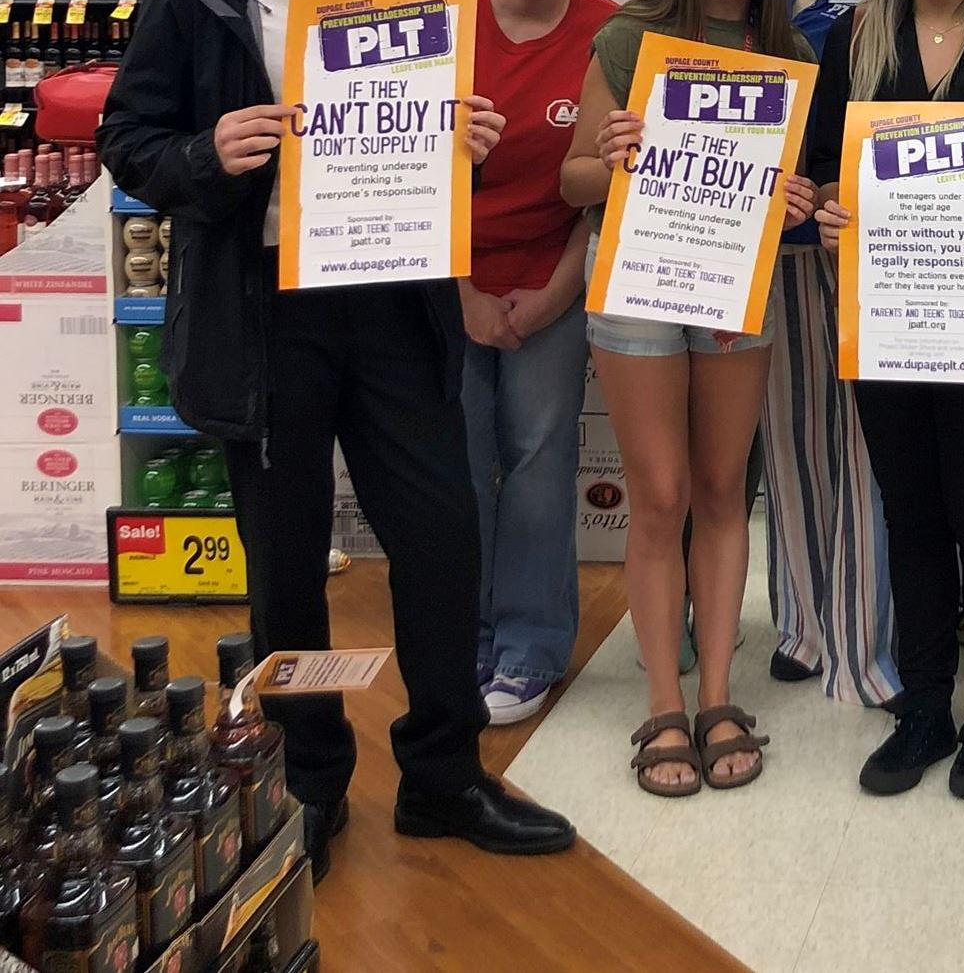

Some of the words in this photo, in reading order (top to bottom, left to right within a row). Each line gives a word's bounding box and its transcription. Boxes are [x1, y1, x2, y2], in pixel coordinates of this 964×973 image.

[347, 18, 424, 66] PLT
[669, 71, 716, 83] PREVENTION
[717, 73, 763, 83] LEADERSHIP
[765, 75, 784, 84] TEAM
[348, 81, 363, 99] IF
[370, 80, 408, 98] THEY
[687, 84, 764, 120] PLT
[290, 102, 369, 136] CAN'T
[376, 100, 429, 134] BUY
[440, 100, 460, 132] IT
[313, 136, 358, 156] DON'T
[360, 136, 418, 154] SUPPLY
[424, 135, 437, 152] IT
[680, 132, 697, 147] IF
[701, 135, 738, 157] THEY
[327, 162, 378, 174] Preventing
[382, 161, 428, 173] underage
[623, 142, 699, 182] CAN'T
[701, 156, 754, 190] BUY
[759, 166, 783, 197] IT
[352, 174, 391, 186] drinking
[394, 175, 402, 184] is
[316, 188, 370, 200] everyone's
[373, 186, 437, 198] responsibility
[639, 178, 681, 199] DON'T
[682, 187, 737, 211] SUPPLY
[741, 196, 756, 212] IT
[915, 203, 933, 211] legal
[648, 204, 696, 221] Preventing
[698, 213, 741, 228] underage
[940, 214, 962, 222] home
[668, 220, 705, 234] drinking
[708, 227, 716, 235] is
[868, 228, 891, 237] with
[896, 229, 907, 237] or
[911, 228, 954, 238] without
[634, 228, 683, 243] everyone's
[685, 235, 746, 253] responsibility
[868, 242, 936, 253] permission,
[941, 245, 961, 254] you
[321, 256, 428, 274] www.dupageplt.org
[871, 256, 909, 268] legally
[937, 283, 954, 291] your
[626, 295, 724, 319] www.dupageplt.org
[19, 394, 94, 405] BERINGER
[21, 481, 96, 492] BERINGER
[119, 525, 160, 538] Sale!
